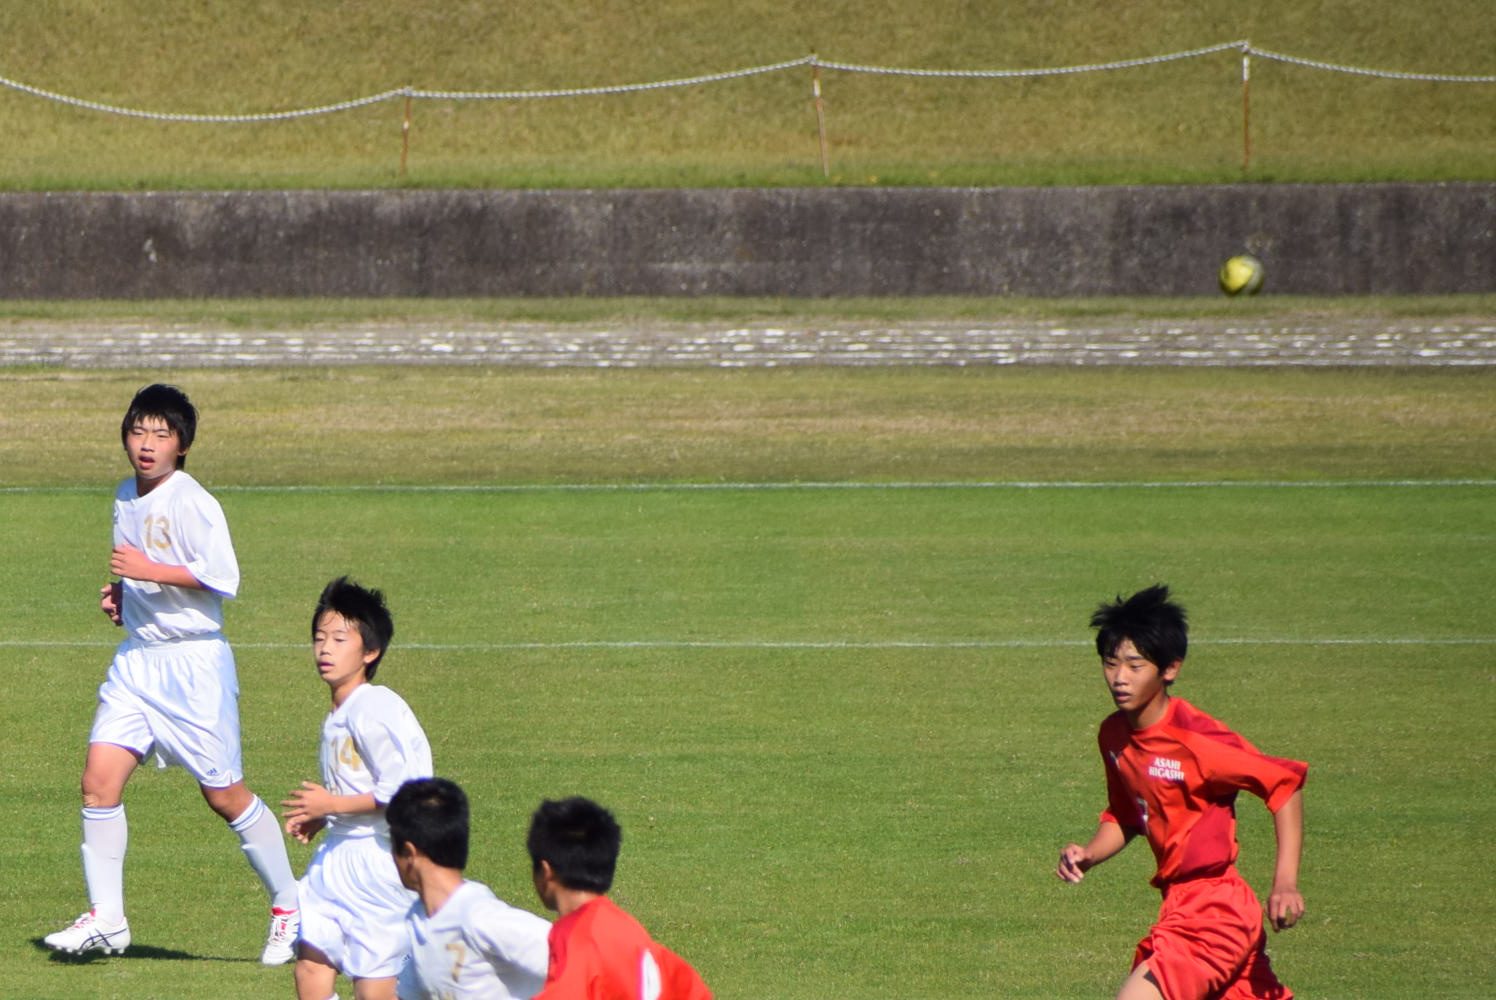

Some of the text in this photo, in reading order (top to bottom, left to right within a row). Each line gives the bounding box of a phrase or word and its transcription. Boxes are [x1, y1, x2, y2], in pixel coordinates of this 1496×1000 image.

[144, 514, 171, 550] 13
[1148, 766, 1184, 780] HIGASHI
[1154, 757, 1181, 769] ASAHI
[445, 943, 466, 983] 7
